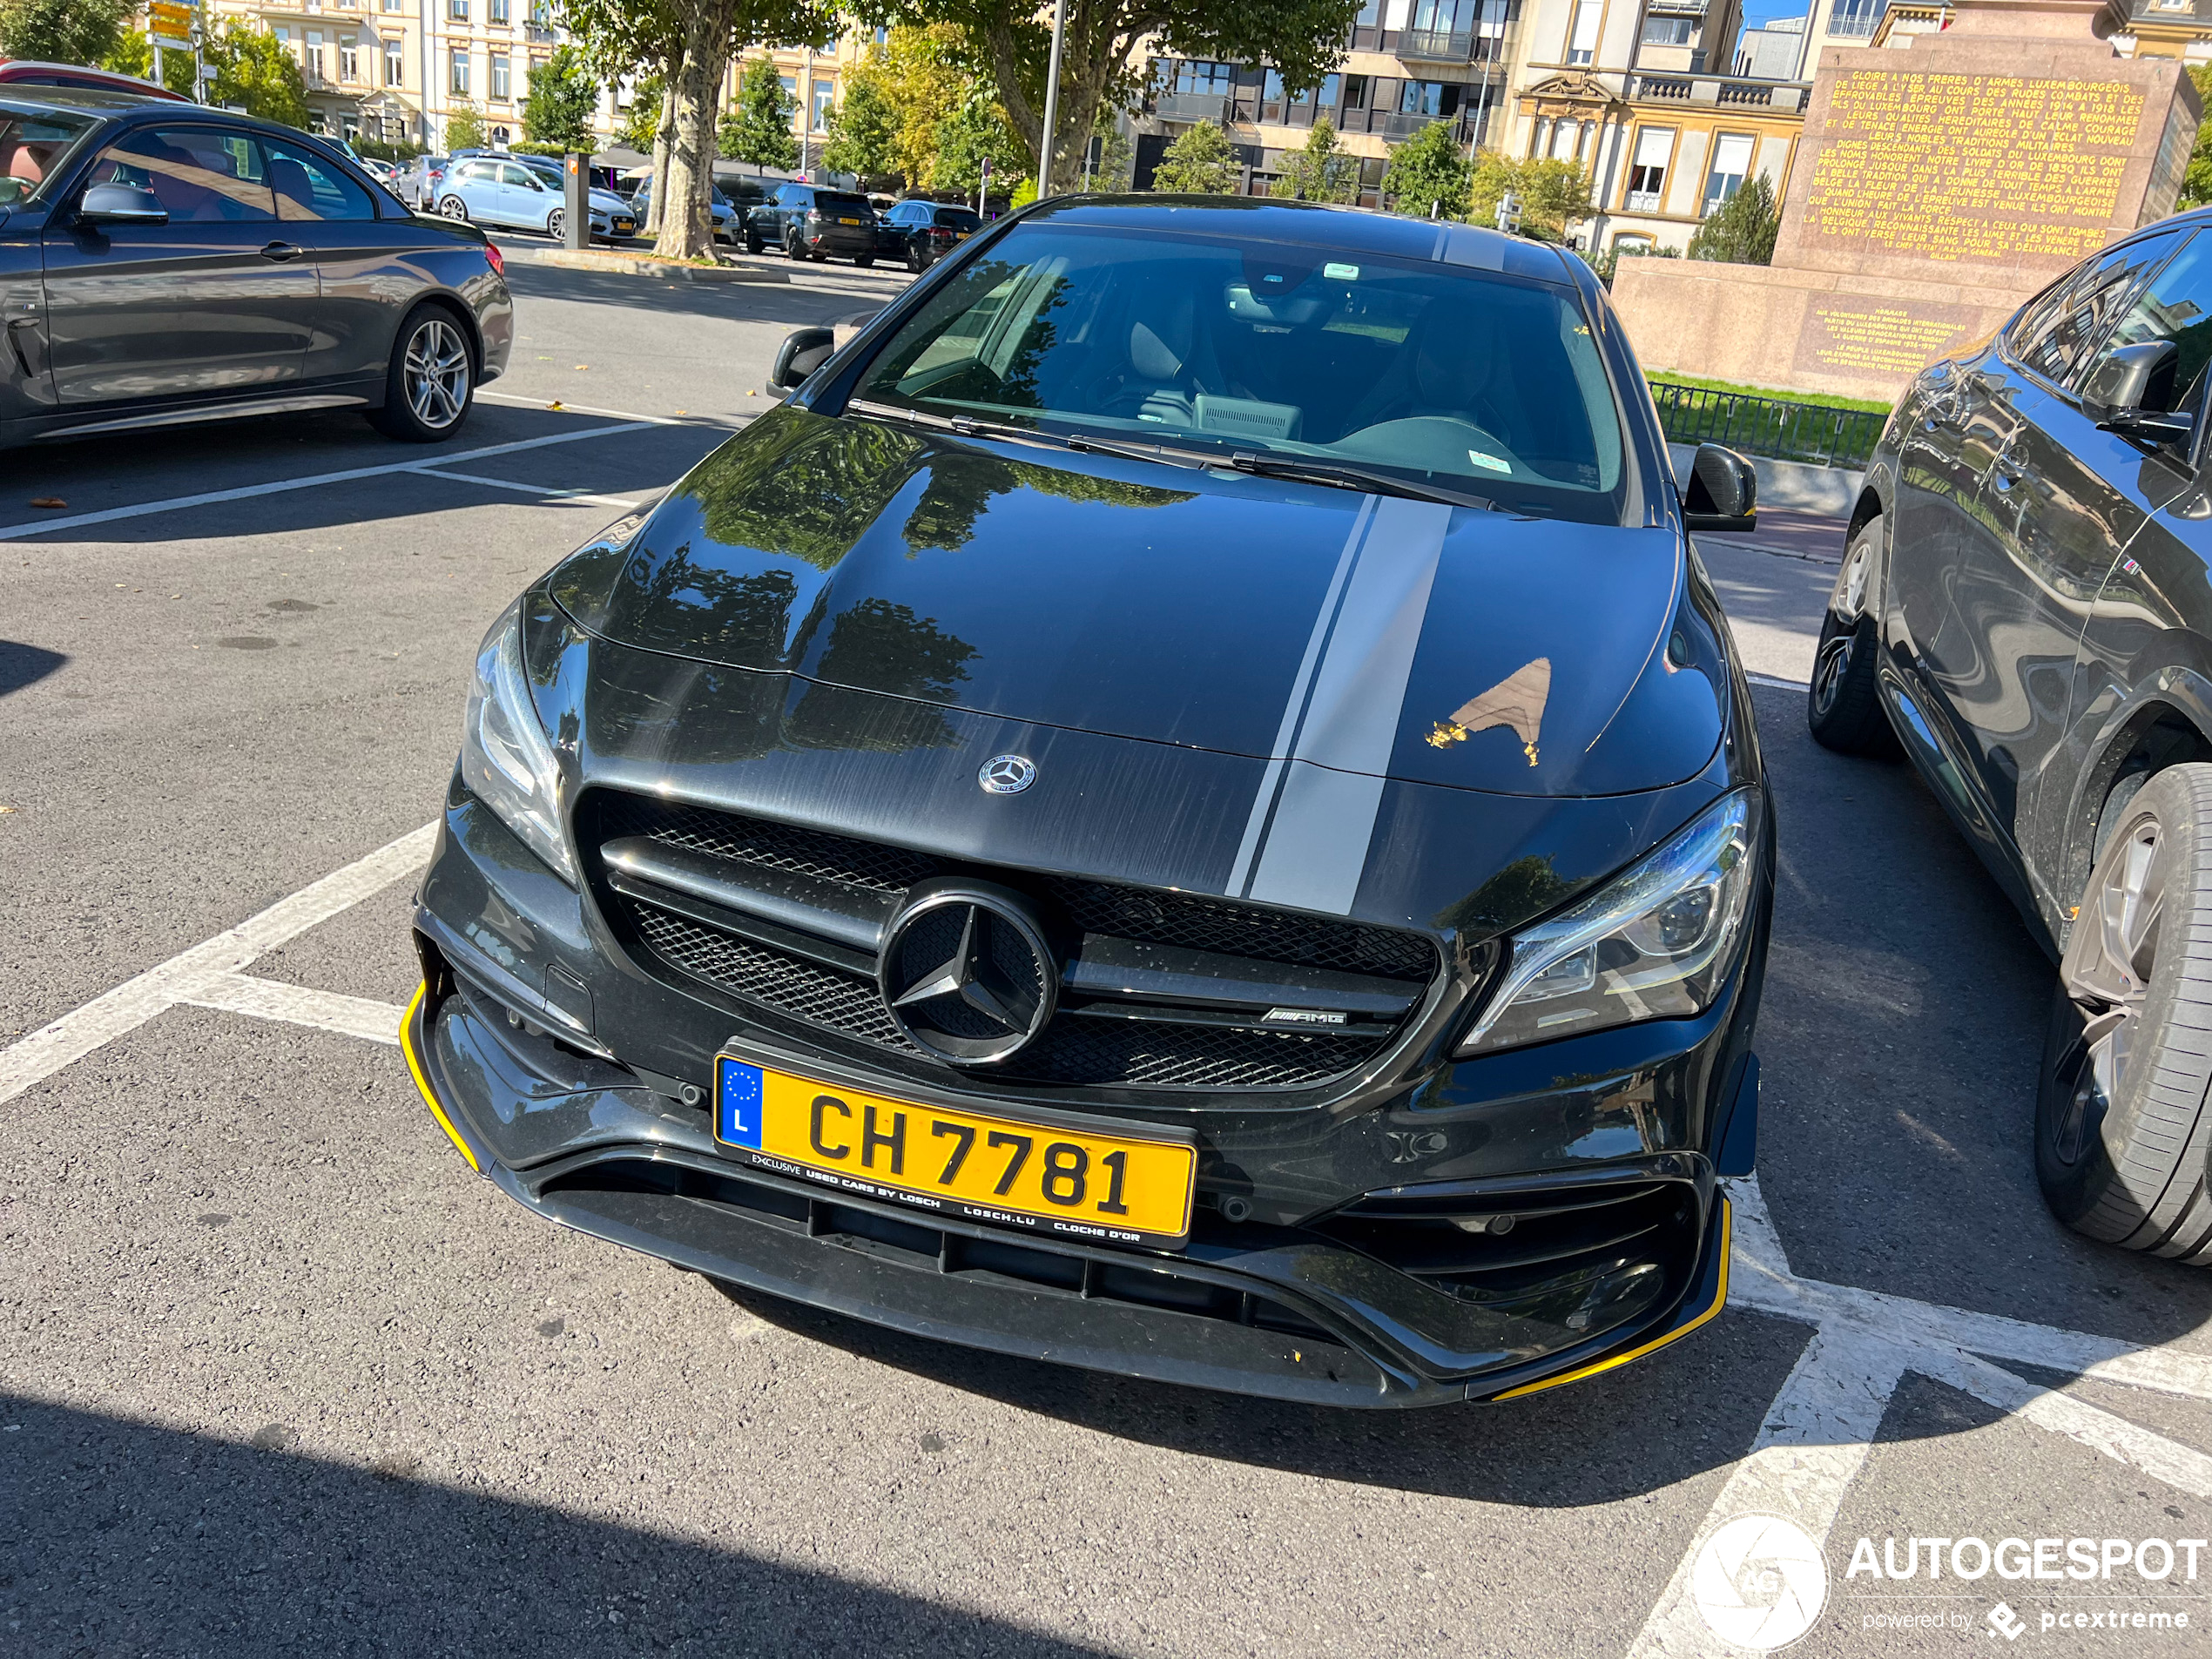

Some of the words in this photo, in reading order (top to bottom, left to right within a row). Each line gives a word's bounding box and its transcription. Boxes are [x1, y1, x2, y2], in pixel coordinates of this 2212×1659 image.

[1851, 71, 1886, 80] GLOIRE
[1901, 73, 1924, 83] NOS
[1929, 84, 1944, 93] AU
[1946, 85, 1980, 95] COURS
[1986, 87, 2006, 97] DES
[2011, 89, 2047, 98] RUDES
[2050, 91, 2101, 102] COMBATS
[2105, 93, 2118, 103] ET
[2122, 94, 2144, 104] DES
[1973, 97, 1995, 106] DES
[2049, 101, 2074, 111] 1914
[2091, 103, 2116, 113] 1918
[2120, 105, 2141, 114] LES
[1831, 99, 1850, 108] FILS
[1853, 100, 1866, 109] DU
[1870, 101, 1938, 113] LUXEMBOURG
[1944, 105, 1965, 115] ONT
[2011, 109, 2039, 118] HAUT
[2044, 111, 2074, 121] LEUR
[1825, 118, 1838, 127] ET
[1842, 119, 1855, 128] DE
[1860, 120, 1896, 131] TENACE
[1947, 125, 1967, 135] ONT
[2086, 134, 2134, 145] NOUVEAU
[1846, 110, 1879, 120] LEURS
[2018, 120, 2033, 129] DE
[2040, 121, 2078, 132] CALME
[2084, 124, 2135, 135] COURAGE
[1868, 131, 1903, 141] LEURS
[1906, 133, 1946, 144] NOBLES
[1951, 136, 2010, 148] TRADITIONS
[1820, 148, 1837, 157] LES
[1839, 149, 1868, 158] NOMS
[1870, 152, 1920, 163] HONORENT
[1926, 155, 1959, 165] NOTRE
[1966, 158, 1992, 167] LIVRE
[2029, 162, 2043, 171] DE
[2080, 165, 2097, 174] ILS
[2101, 166, 2122, 176] ONT
[1837, 139, 1868, 149] DIGNES
[1870, 141, 1932, 153] DESCENDANTS
[1937, 145, 1956, 155] DES
[1961, 147, 2002, 158] SOLDATS
[2007, 151, 2023, 159] DU
[2027, 152, 2097, 164] LUXEMBOURG
[2099, 156, 2127, 166] DONT
[570, 160, 577, 172] P
[1870, 161, 1907, 172] JUSQUE
[1912, 164, 1939, 174] DANS
[1943, 166, 1957, 175] LA
[1963, 167, 1986, 177] PLUS
[1993, 170, 2040, 181] TERRIBLE
[2044, 173, 2066, 183] DES
[2070, 175, 2121, 186] GUERRES
[1812, 177, 1843, 186] BELGE
[1848, 179, 1860, 188] LA
[1865, 180, 1897, 191] FLEUR
[1923, 185, 1939, 193] LA
[1944, 186, 2000, 198] JEUNESSE
[2007, 191, 2115, 206] LUXEMBOURGEOISE
[1830, 168, 1858, 178] BELLE
[1862, 171, 1908, 181] TRADITION
[1912, 174, 1928, 183] QUI
[1981, 179, 1995, 187] DE
[2000, 180, 2023, 190] TOUT
[2027, 182, 2062, 192] TEMPS
[1824, 187, 1855, 197] QUAND
[1896, 192, 1910, 201] DE
[1971, 199, 1989, 207] EST
[1993, 200, 2025, 210] VENUE
[2031, 203, 2047, 212] ILS
[2049, 204, 2069, 213] ONT
[1877, 201, 1898, 210] FAIT
[1804, 214, 1816, 224] LA
[1820, 216, 1867, 228] BELGIQUE
[1873, 220, 1959, 235] RECONNAISSANTE
[1962, 227, 1979, 237] LES
[1982, 229, 2005, 239] AIME
[2009, 232, 2020, 240] ET
[2025, 233, 2043, 243] LES
[2083, 238, 2103, 247] CAR
[1820, 206, 1865, 218] HONNEUR
[1868, 211, 1887, 219] AUX
[1893, 212, 1932, 223] VIVANTS
[1937, 216, 1978, 227] RESPECT
[1992, 220, 2017, 230] CEUX
[2020, 223, 2038, 232] QUI
[2040, 225, 2064, 234] SONT
[1822, 226, 1838, 234] ILS
[1840, 227, 1860, 236] ONT
[1901, 232, 1927, 242] LEUR
[1932, 235, 1959, 245] SANG
[1963, 238, 1991, 247] POUR
[1996, 240, 2010, 249] SA
[1293, 1013, 1344, 1023] AMG
[733, 1108, 748, 1132] L
[809, 1095, 907, 1176] CH
[931, 1119, 1129, 1216] 7781
[752, 1154, 800, 1176] EXCLUSIVE
[806, 1169, 838, 1186] USED
[842, 1178, 875, 1194] CARS
[878, 1186, 896, 1197] BY
[899, 1192, 941, 1208] LOSCH
[963, 1207, 1035, 1226] LOSCH.LU
[1054, 1222, 1106, 1238] CLOCHE
[1109, 1229, 1141, 1242] D'OR
